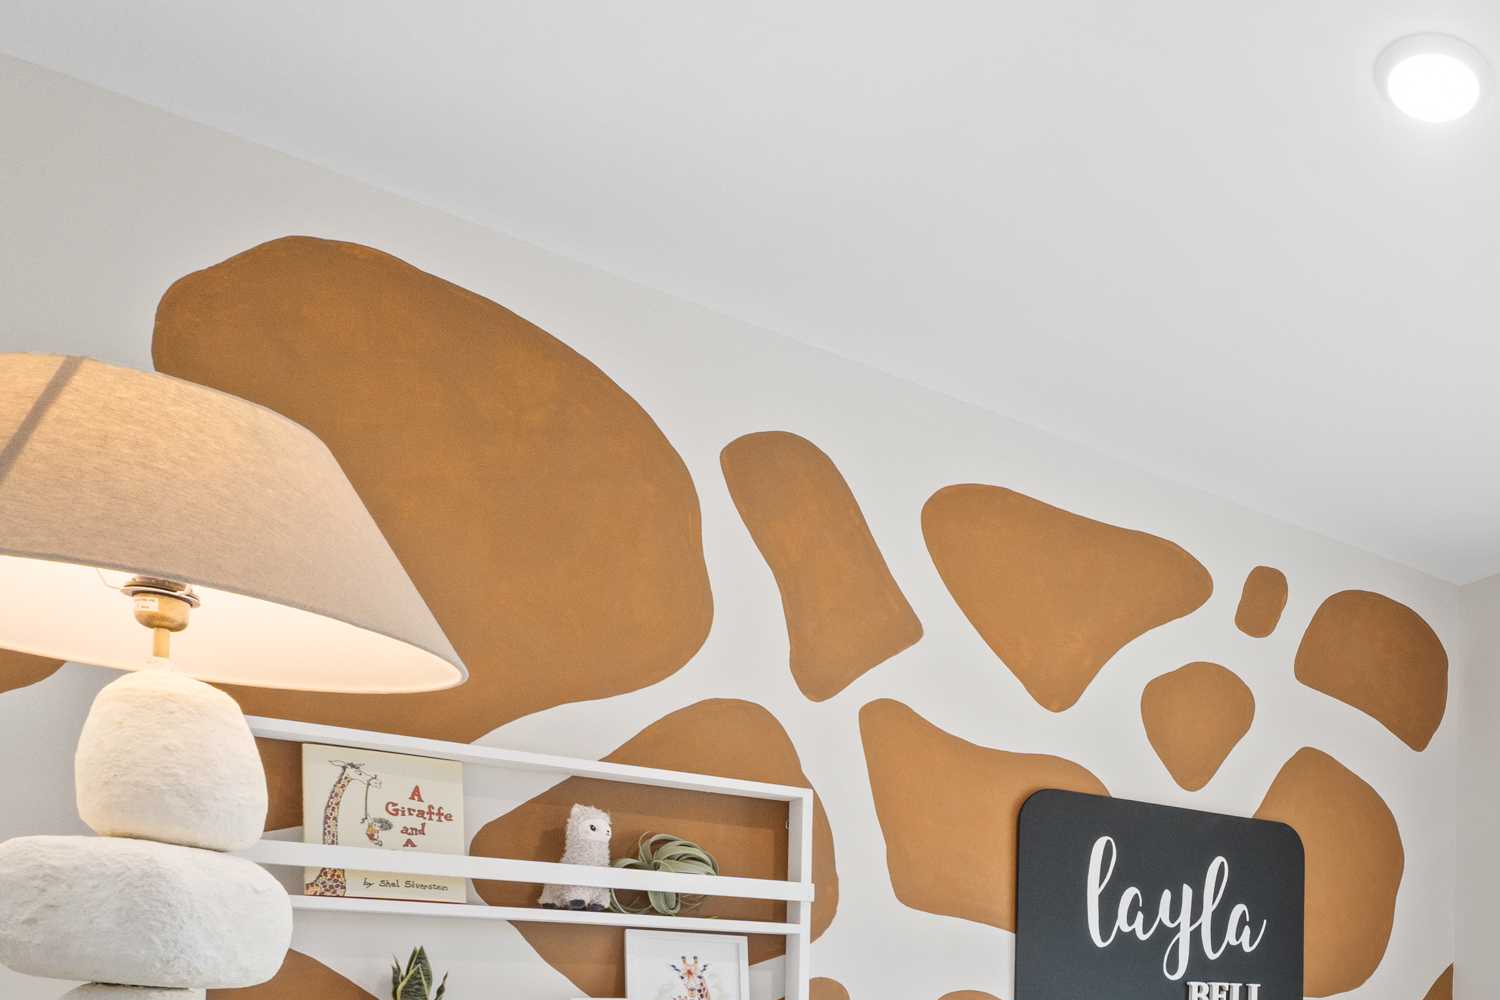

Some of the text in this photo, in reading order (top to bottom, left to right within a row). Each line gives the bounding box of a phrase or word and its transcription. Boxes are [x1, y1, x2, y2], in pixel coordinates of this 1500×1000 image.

[408, 785, 424, 802] A
[385, 801, 453, 822] Giraffe
[400, 823, 426, 836] and
[363, 877, 374, 888] by
[379, 880, 400, 888] Shel
[1087, 836, 1267, 980] layla
